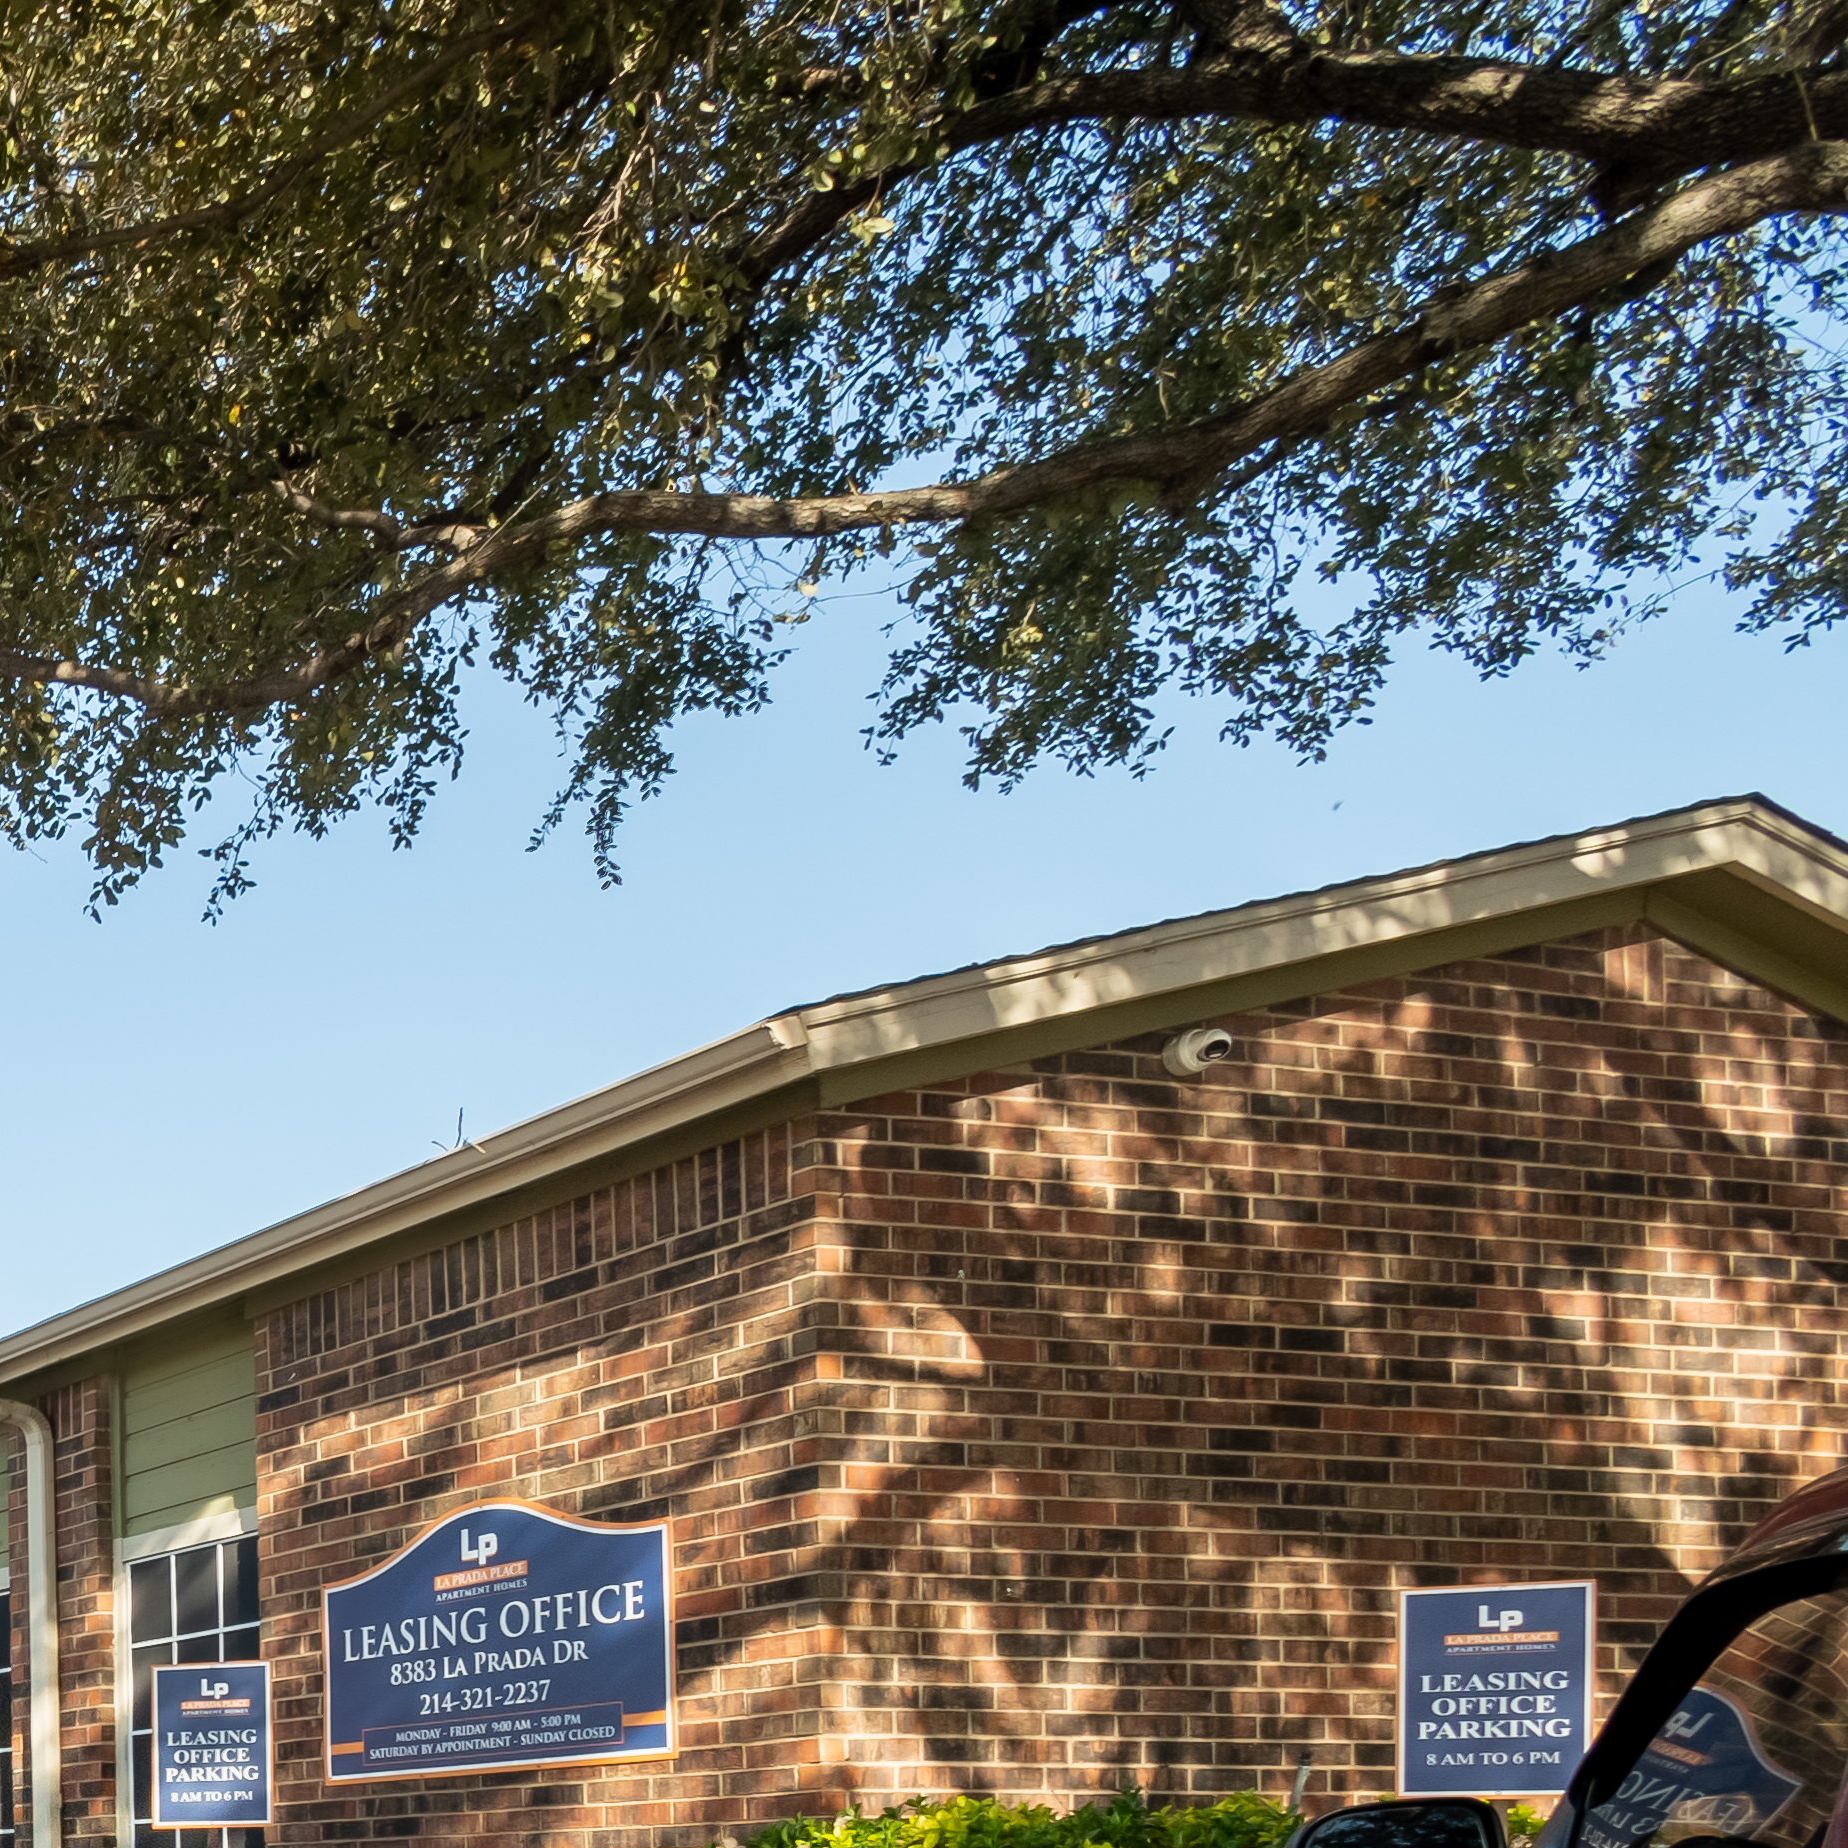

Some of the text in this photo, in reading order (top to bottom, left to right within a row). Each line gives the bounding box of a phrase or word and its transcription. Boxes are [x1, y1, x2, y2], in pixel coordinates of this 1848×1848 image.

[437, 1562, 524, 1588] LA PRADA PLACE
[436, 1578, 527, 1602] APARTMENT HOMES
[343, 1580, 645, 1663] LEASING OFFICE
[390, 1658, 436, 1686] 8383
[1420, 1670, 1569, 1693] LEASING
[420, 1679, 551, 1717] 214-321-2237
[1431, 1695, 1556, 1716] OFFICE
[167, 1729, 257, 1747] LEASING
[395, 1728, 441, 1743] MONDAY
[449, 1723, 487, 1737] FRIDAY
[491, 1720, 511, 1733] 9:00
[513, 1718, 531, 1731] AM
[541, 1715, 561, 1728] 5:00
[564, 1714, 581, 1726] PM
[1417, 1718, 1572, 1740] PARKING
[369, 1745, 419, 1760] SATURDAY
[421, 1742, 435, 1755] BY
[434, 1736, 511, 1754] APPOINTMENT
[520, 1731, 567, 1746] SUNDAY
[568, 1726, 615, 1741] CLOSED
[173, 1748, 250, 1764] OFFICE
[1426, 1751, 1560, 1766] 8 AM TO 6 PM
[165, 1765, 259, 1783] PARKING
[171, 1790, 253, 1802] 8 AM TO 6 PM
